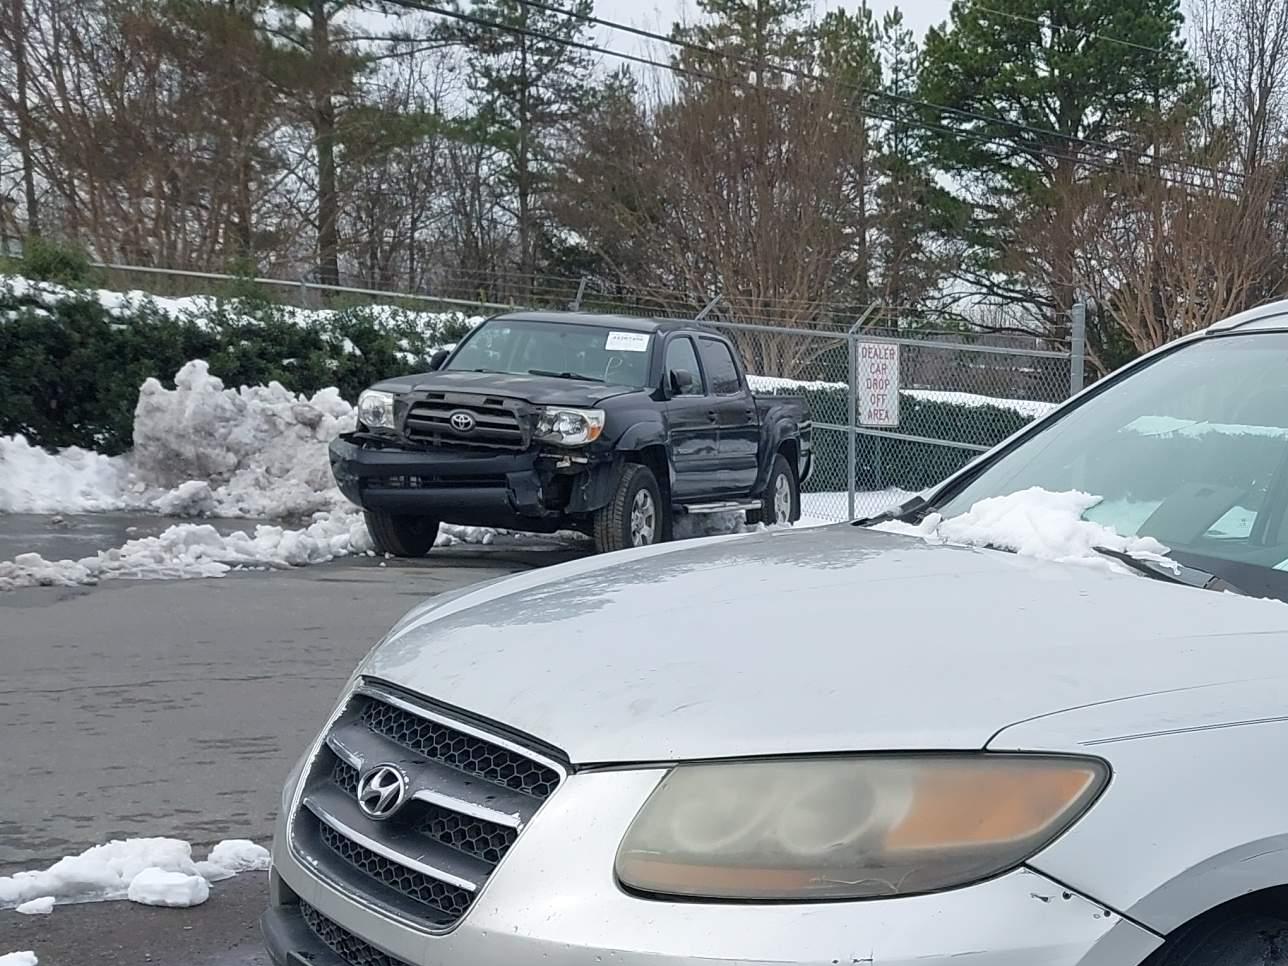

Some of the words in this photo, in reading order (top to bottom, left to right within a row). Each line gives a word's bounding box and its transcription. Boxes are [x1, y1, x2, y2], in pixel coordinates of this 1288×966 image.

[861, 346, 896, 360] DEALER
[869, 362, 887, 375] CAR
[866, 378, 890, 390] DROP
[870, 393, 887, 407] OFF
[867, 408, 890, 422] AREA
